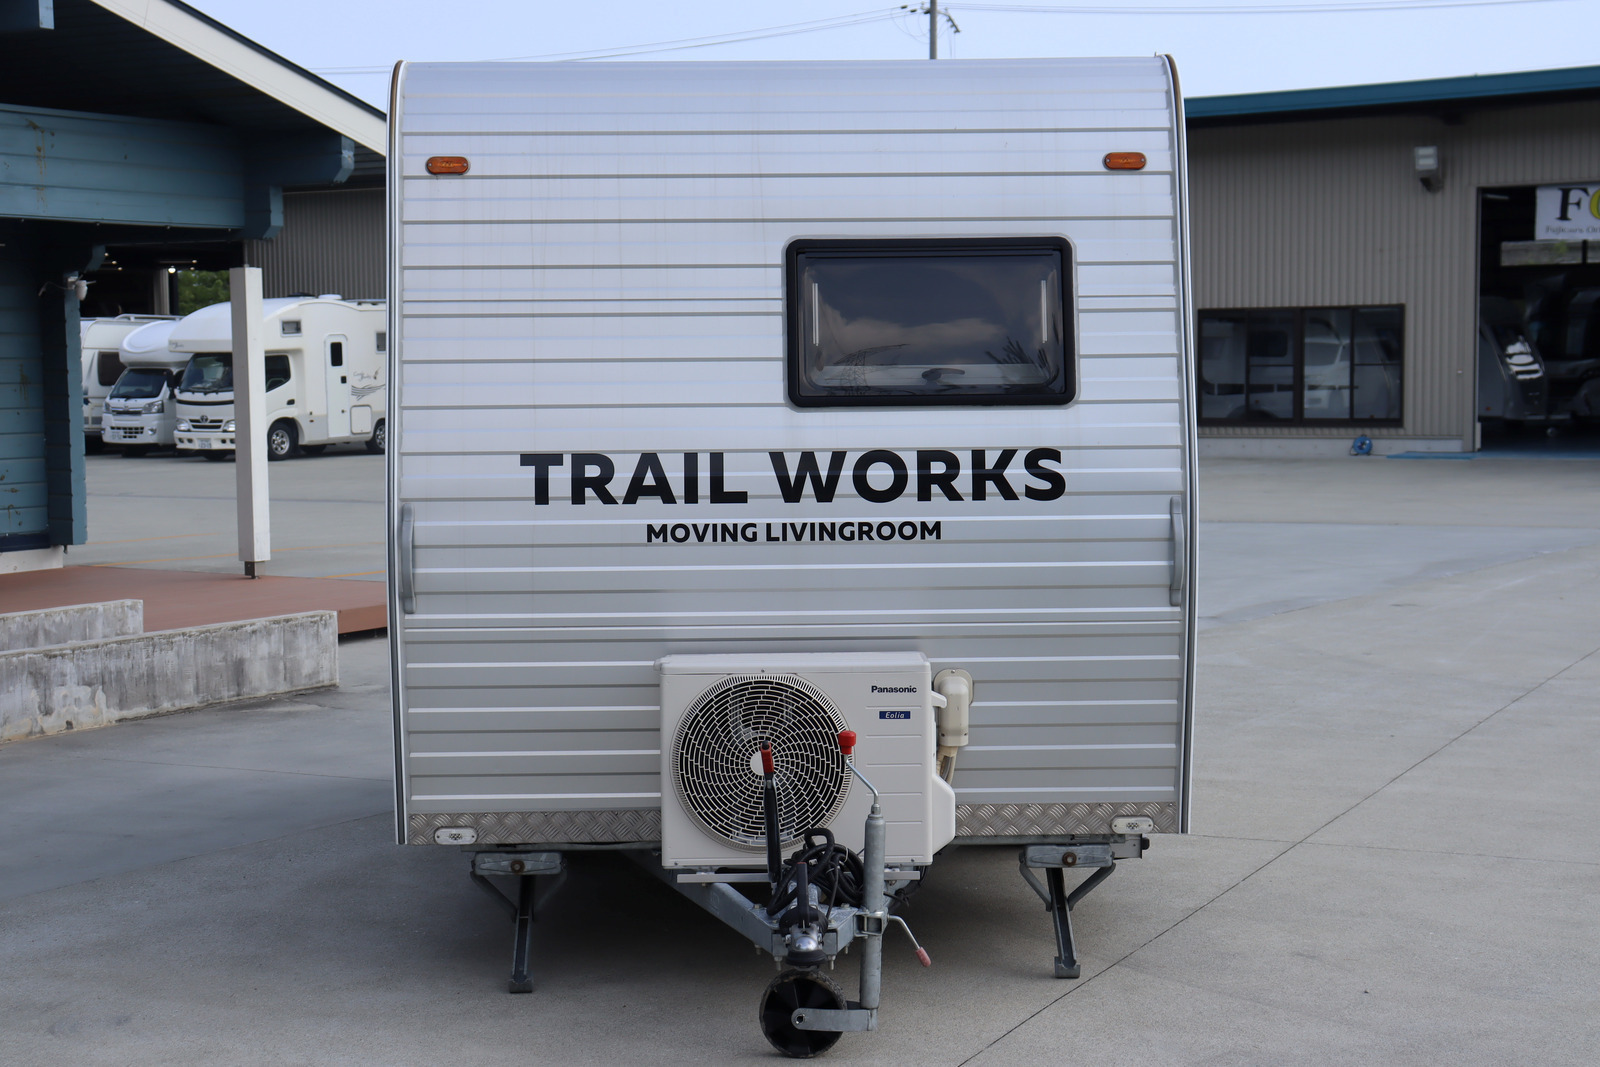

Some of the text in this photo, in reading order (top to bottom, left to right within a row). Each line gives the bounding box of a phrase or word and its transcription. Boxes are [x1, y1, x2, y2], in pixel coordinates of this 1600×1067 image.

[519, 447, 1066, 505] TRAIL WORKS
[646, 520, 942, 543] MOVING LIVINGROOM
[871, 685, 917, 693] Panasonic
[885, 711, 905, 719] Eolia
